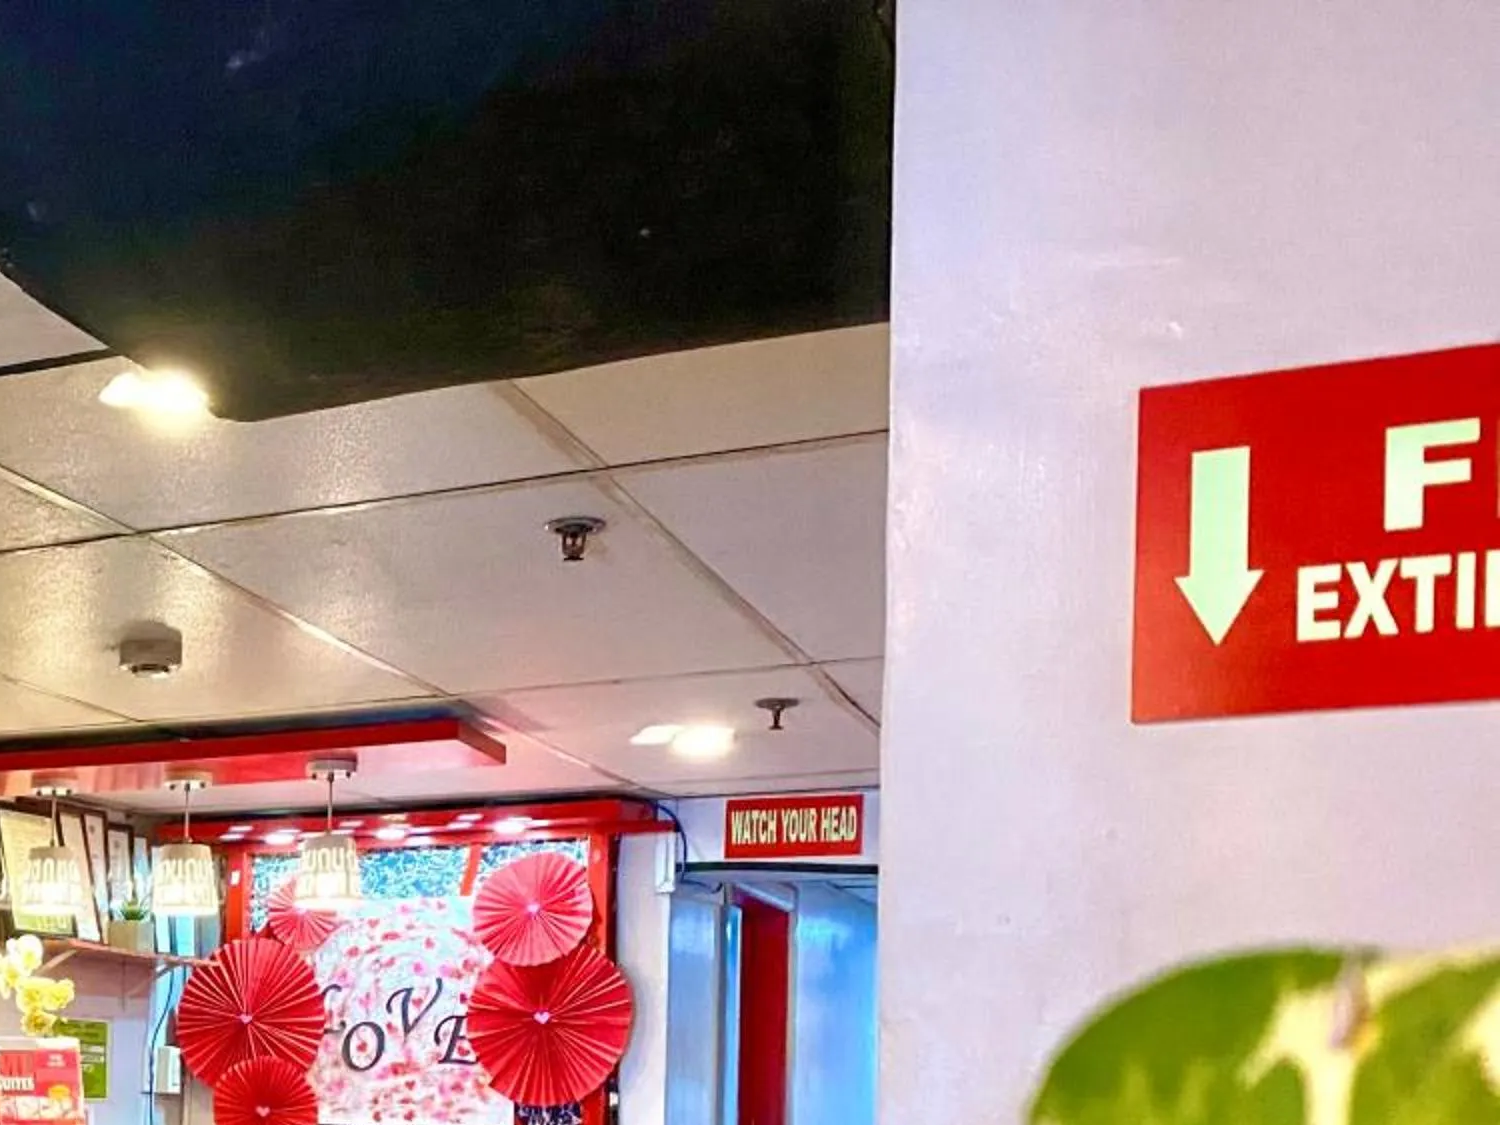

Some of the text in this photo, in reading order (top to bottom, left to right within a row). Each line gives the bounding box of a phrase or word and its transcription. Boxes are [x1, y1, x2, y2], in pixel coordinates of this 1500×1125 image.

[1384, 416, 1500, 533] F
[731, 805, 858, 845] WATCH YOUR HEAD
